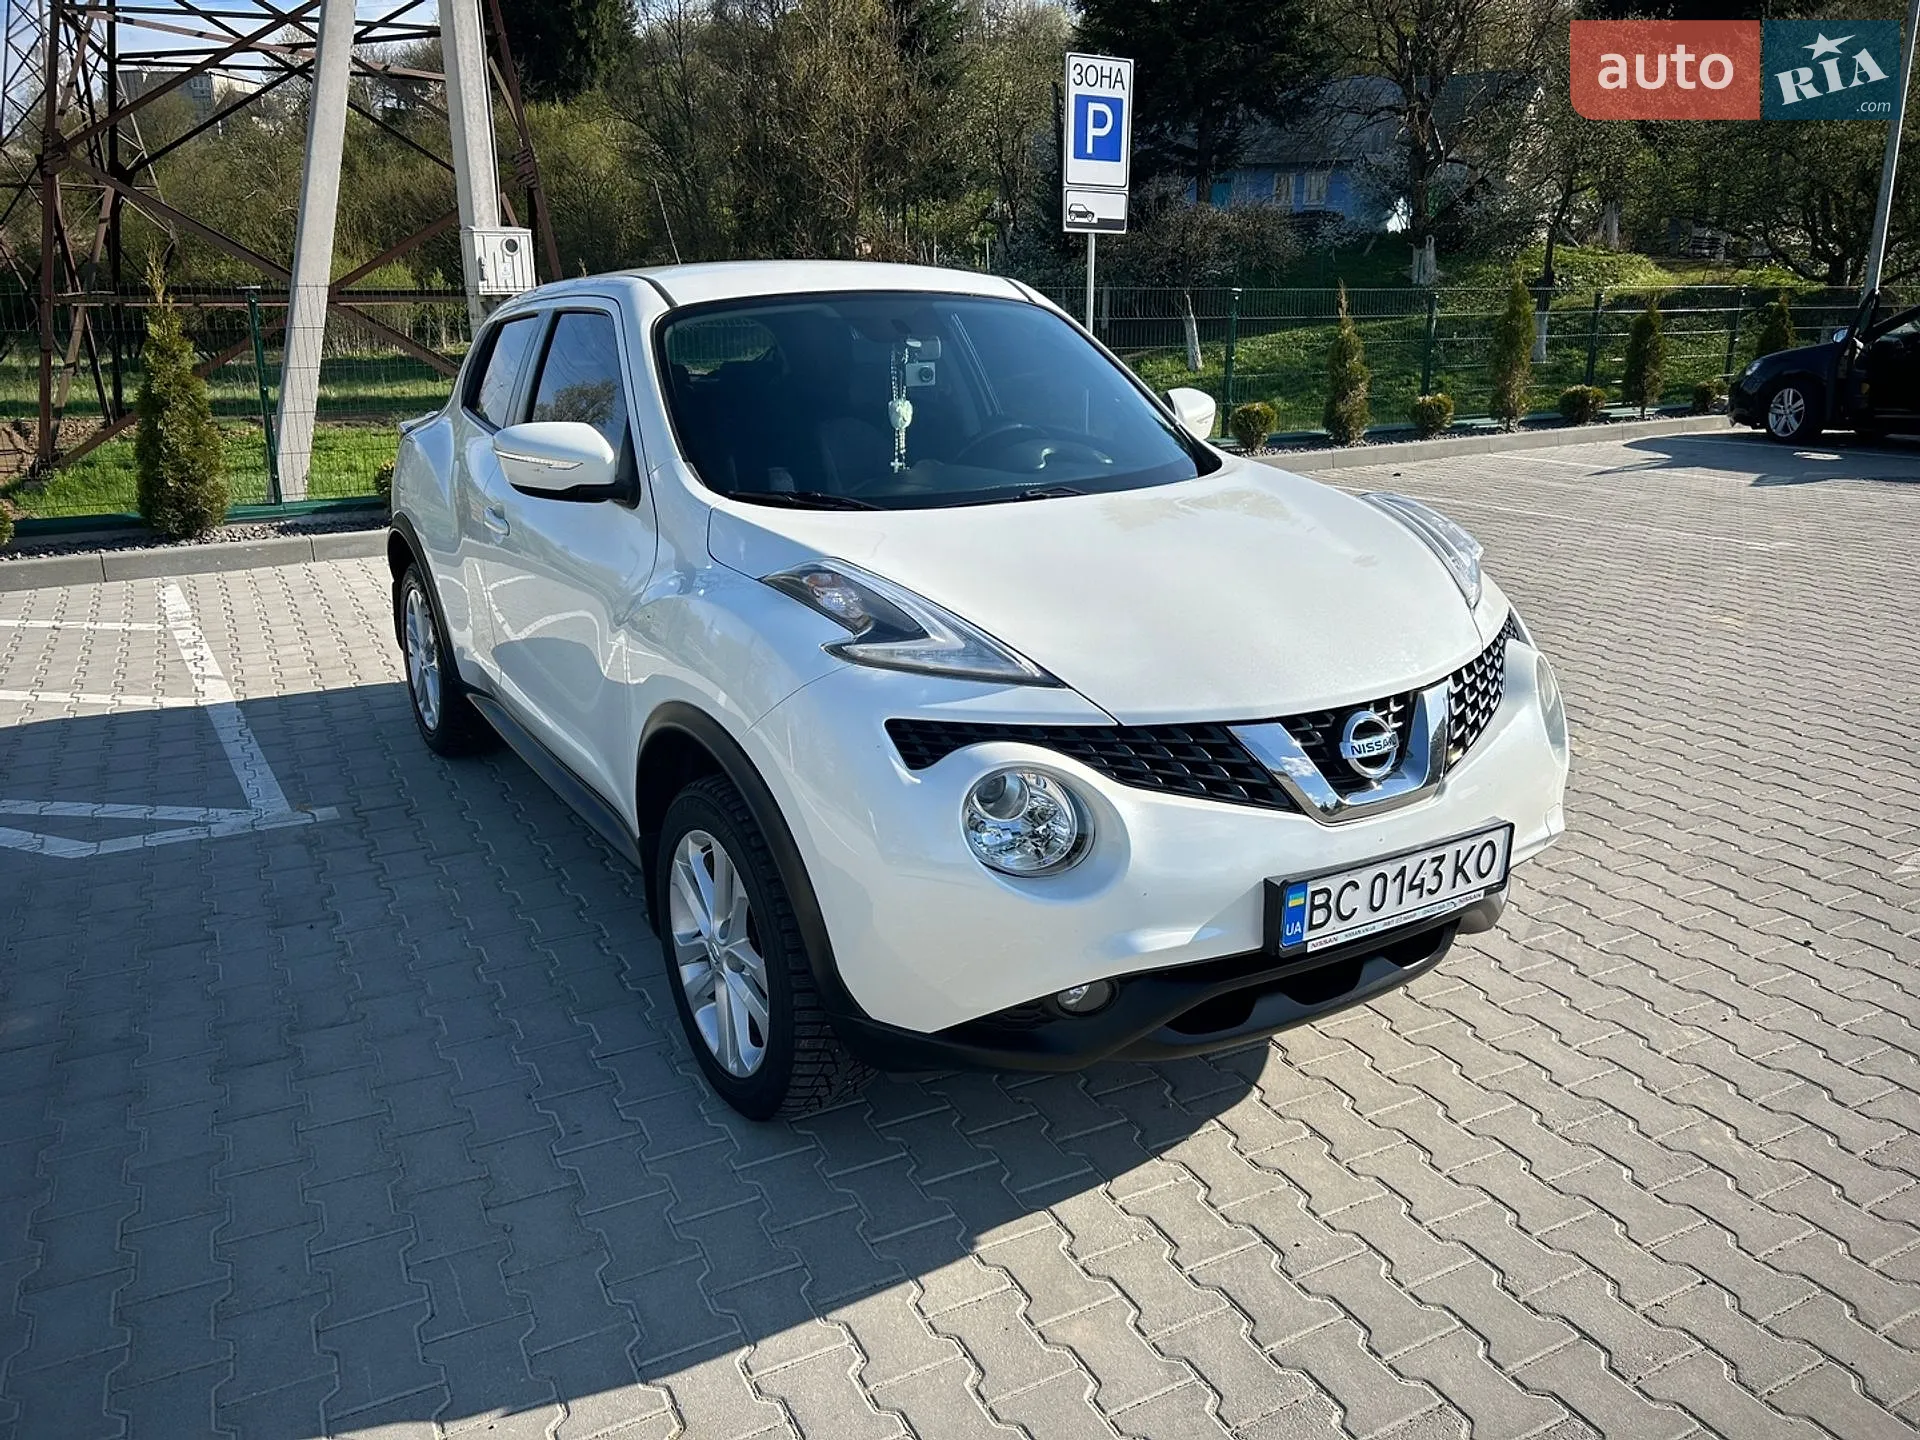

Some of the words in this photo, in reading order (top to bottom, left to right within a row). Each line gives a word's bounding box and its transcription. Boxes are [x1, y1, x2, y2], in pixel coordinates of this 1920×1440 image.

[1073, 63, 1125, 90] ЗОНА
[1086, 102, 1114, 154] P
[1350, 733, 1397, 755] NISSAN
[1308, 879, 1360, 932] BC
[1369, 854, 1445, 914] 0143
[1452, 839, 1497, 889] KO
[1286, 922, 1302, 936] UA
